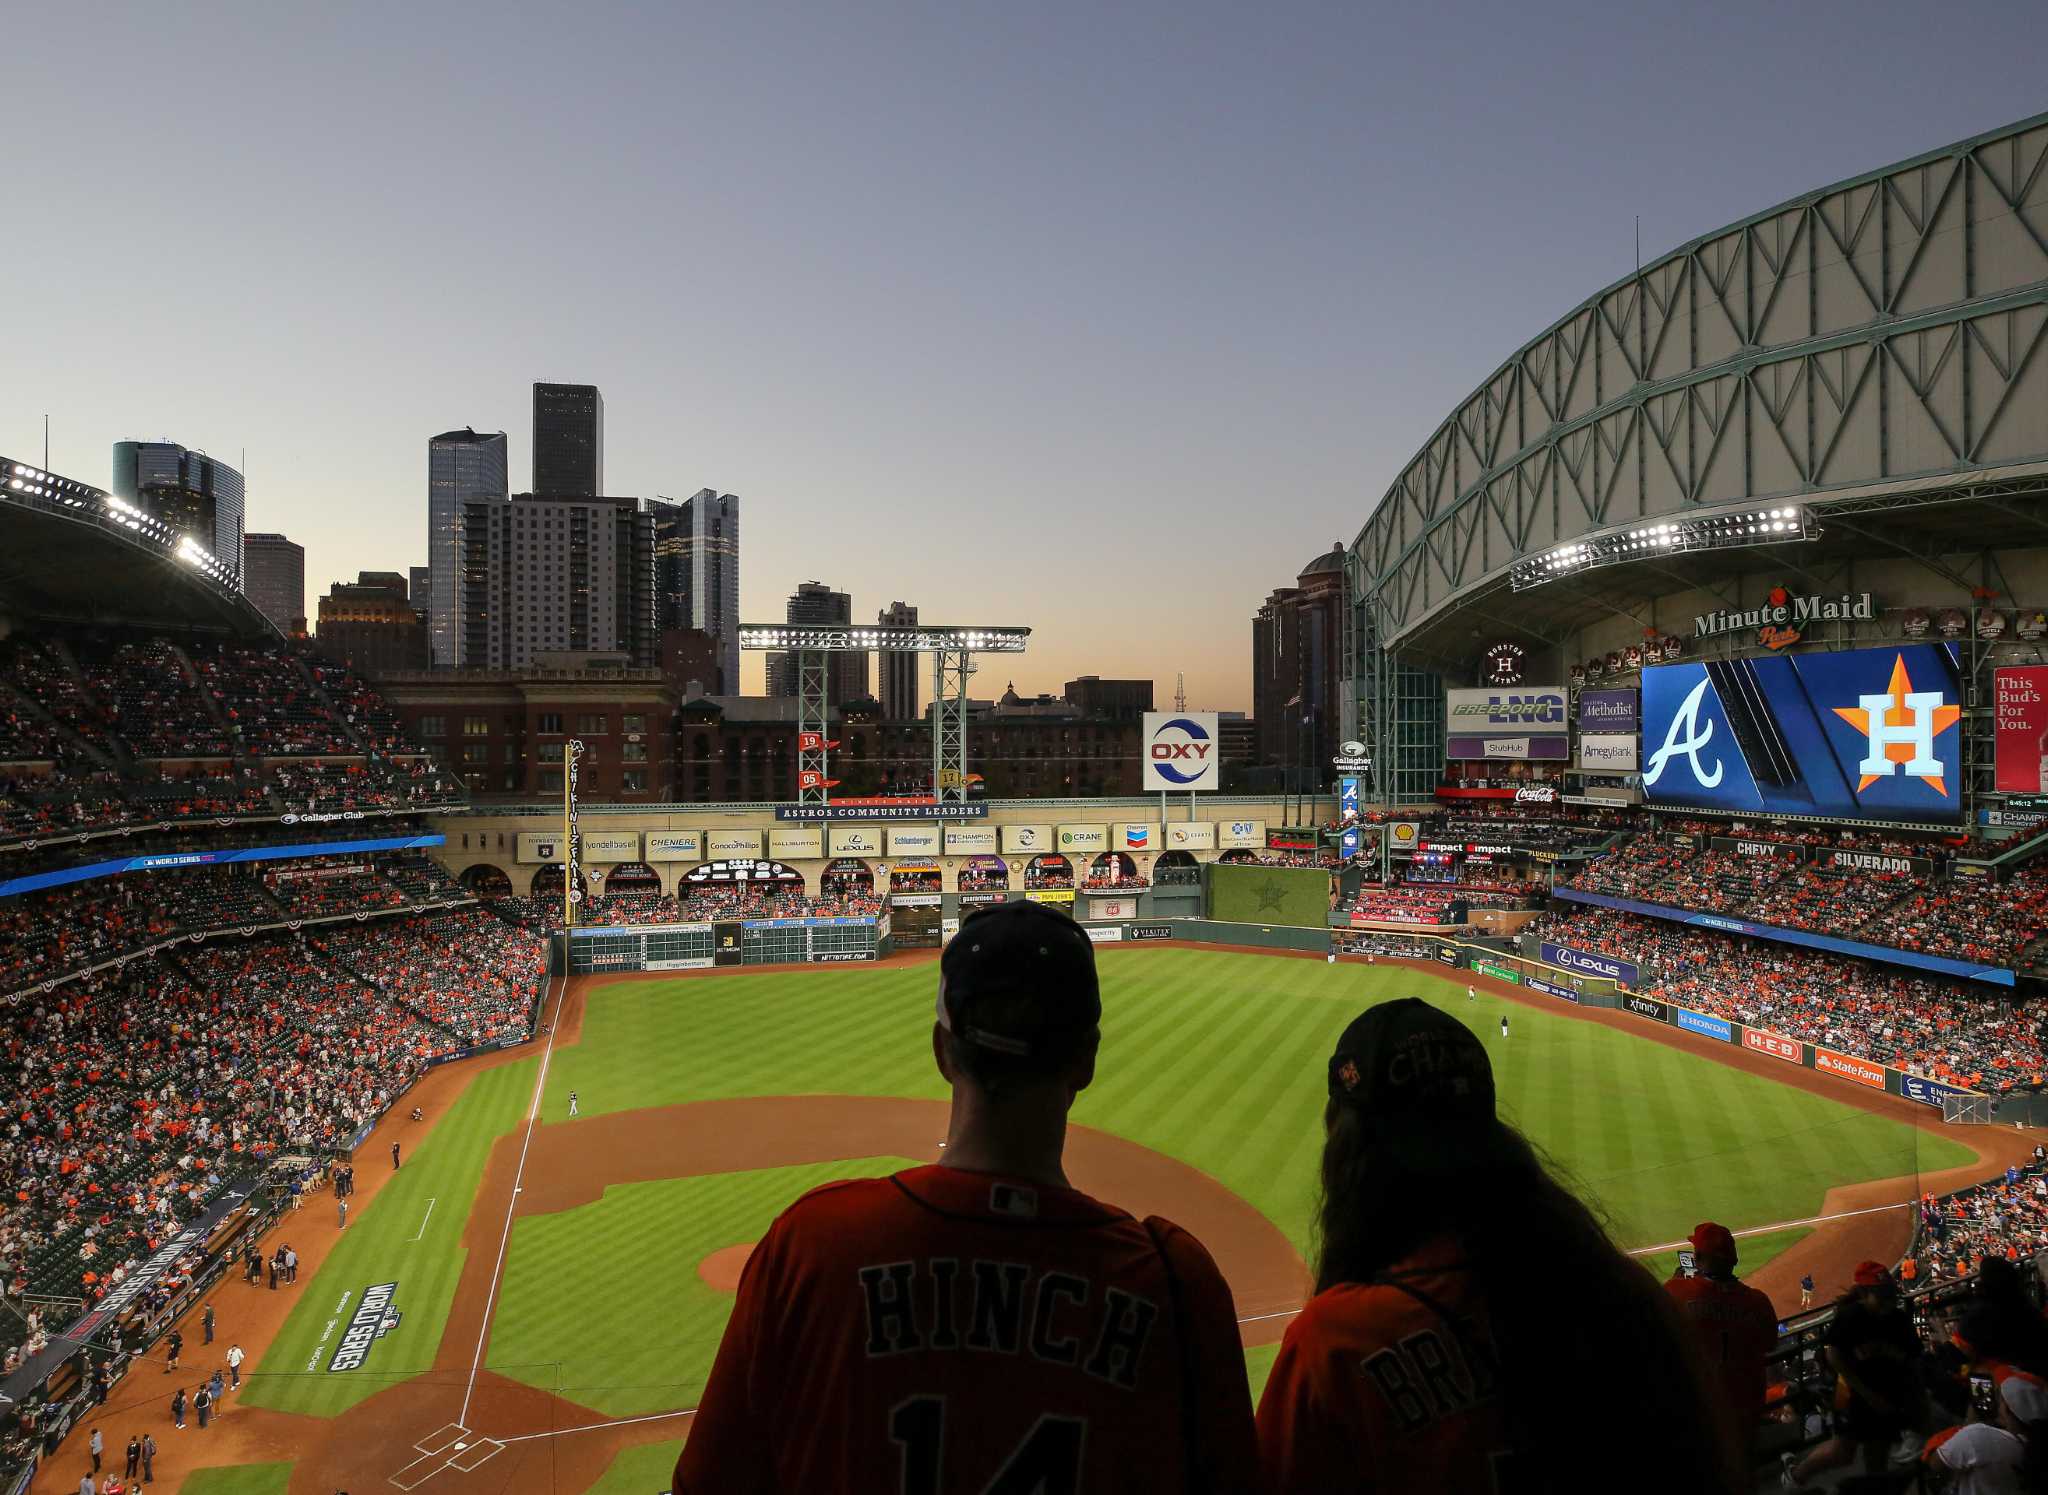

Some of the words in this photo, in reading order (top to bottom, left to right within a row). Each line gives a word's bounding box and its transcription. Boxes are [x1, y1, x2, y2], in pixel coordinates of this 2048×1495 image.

[1694, 606, 1788, 638] Minute
[1793, 593, 1874, 621] Maid
[1759, 626, 1800, 649] Park
[1487, 644, 1524, 657] HOUSTON
[1496, 657, 1513, 672] H
[1489, 673, 1523, 684] ASTROS
[1998, 677, 2033, 689] This
[1999, 690, 2041, 703] Bud's
[1455, 703, 1546, 715] FREEPORT
[1488, 694, 1564, 723] LNG
[1583, 701, 1633, 717] Methodist
[1999, 705, 2025, 717] For
[1998, 718, 2032, 730] You.
[803, 736, 816, 746] 19
[1859, 692, 1944, 777] H
[1151, 743, 1211, 760] OXY
[1488, 743, 1524, 753] StubHub
[1584, 745, 1633, 760] AmegyBank
[1332, 756, 1373, 766] Gallagher
[803, 774, 816, 784] 05
[943, 773, 954, 783] 17
[569, 763, 579, 823] CHIKIN
[1515, 788, 1553, 802] Coca-Cola
[300, 813, 342, 823] Gallagher
[343, 811, 365, 821] Club
[838, 807, 920, 817] COMMUNITY
[925, 806, 981, 816] LEADERS
[571, 824, 580, 844] IZ
[1073, 833, 1102, 841] CRANE
[650, 838, 697, 847] CHENIERE
[710, 841, 760, 850] ConocoPhillips
[894, 836, 932, 846] Schlumberger
[836, 844, 874, 852] LEXUS
[1427, 843, 1463, 853] impact
[1474, 845, 1511, 854] impact
[1737, 843, 1776, 856] CHEVY
[155, 857, 178, 865] WORLD
[179, 855, 201, 864] SERIES
[1834, 853, 1911, 873] SILVERADO
[1572, 955, 1620, 977] LEXUS
[1629, 995, 1660, 1017] xfinity
[1687, 1017, 1730, 1036] HONDA
[136, 1241, 191, 1275] WORLD
[94, 1275, 152, 1312] SERIES
[353, 1283, 395, 1325] WORLD
[859, 1258, 1159, 1391] HINCH
[330, 1325, 375, 1371] SERIES
